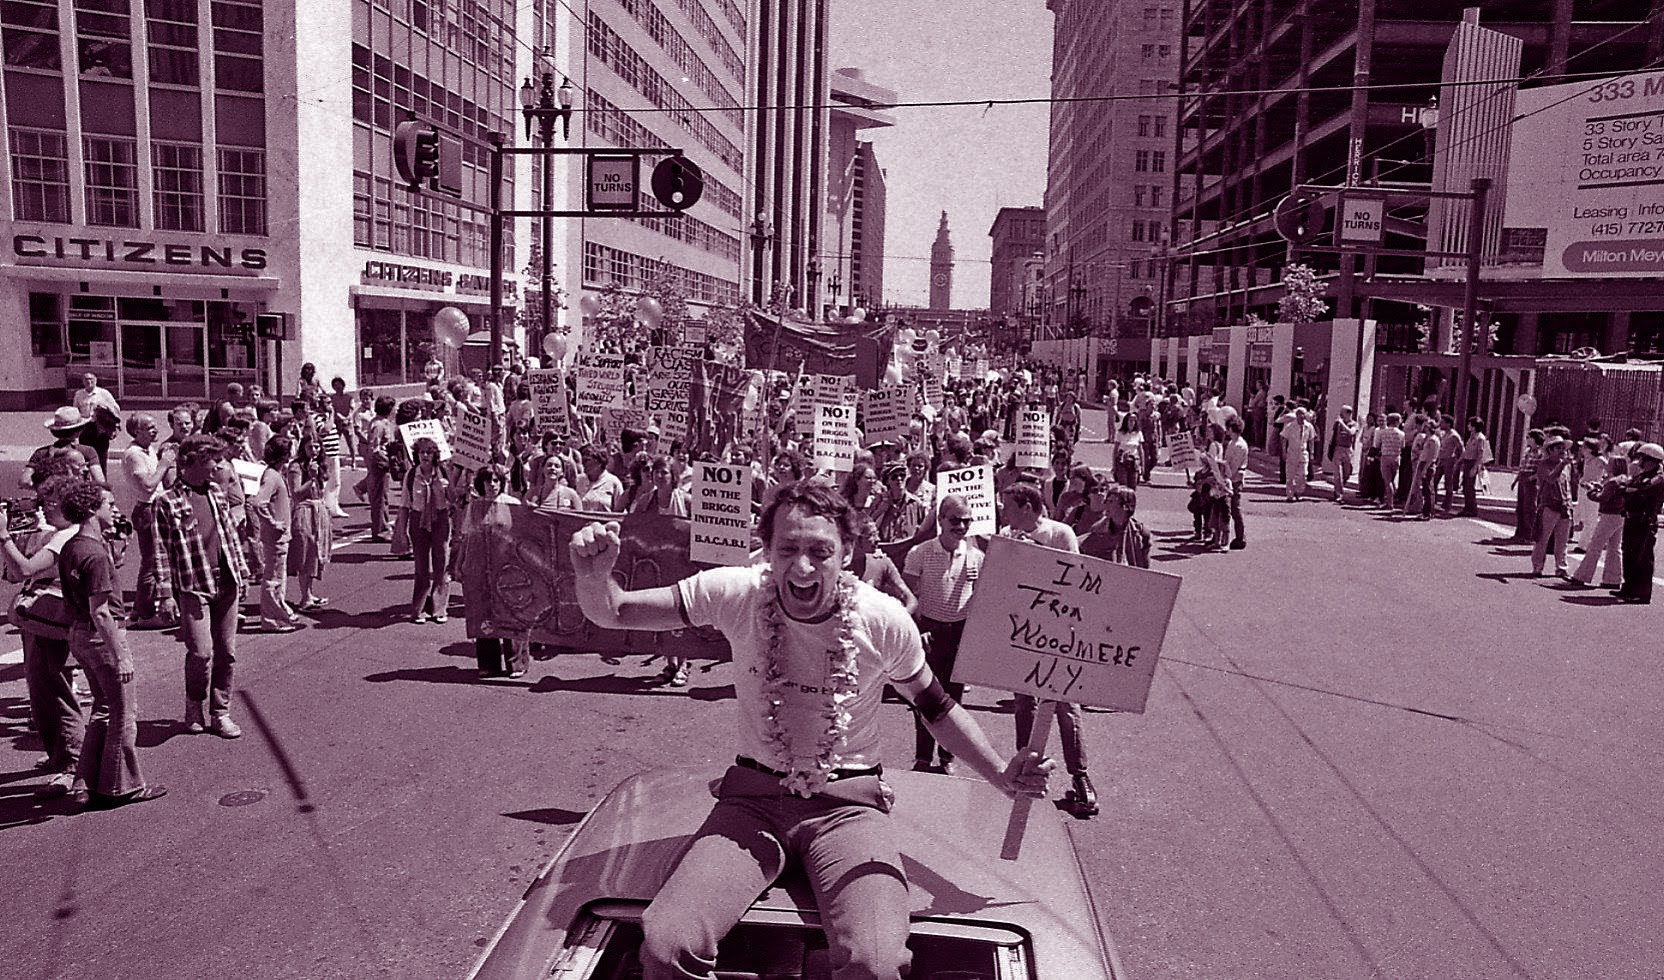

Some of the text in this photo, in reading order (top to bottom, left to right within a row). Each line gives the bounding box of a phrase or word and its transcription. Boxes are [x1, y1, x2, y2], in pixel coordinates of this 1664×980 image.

[1587, 81, 1635, 103] 333
[1584, 122, 1605, 136] 33
[1612, 117, 1652, 133] Story
[1582, 132, 1664, 151] 5 Story Sa
[1582, 151, 1614, 166] Total
[1617, 150, 1650, 164] area
[604, 173, 620, 183] NO
[1579, 164, 1662, 181] Occupancy
[593, 182, 632, 192] TURNS
[1354, 211, 1370, 221] NO
[1573, 206, 1628, 220] Leasing
[1344, 219, 1380, 231] TURNS
[1591, 222, 1623, 235] (415)
[12, 234, 268, 270] CITIZENS
[1582, 250, 1626, 263] Milton
[366, 260, 452, 287] CITIZENS
[820, 376, 842, 386] NO!
[870, 390, 891, 401] NO!
[822, 406, 850, 419] NO!
[1023, 412, 1045, 423] NO!
[408, 421, 434, 431] NO!
[463, 412, 487, 428] NO!
[702, 466, 742, 486] NO!
[948, 468, 984, 484] NO!
[701, 488, 740, 501] ON THE
[965, 484, 984, 492] THE
[701, 501, 741, 514] BRIGGS
[694, 513, 747, 529] INITIATIVE
[1024, 657, 1083, 695] N.Y.
